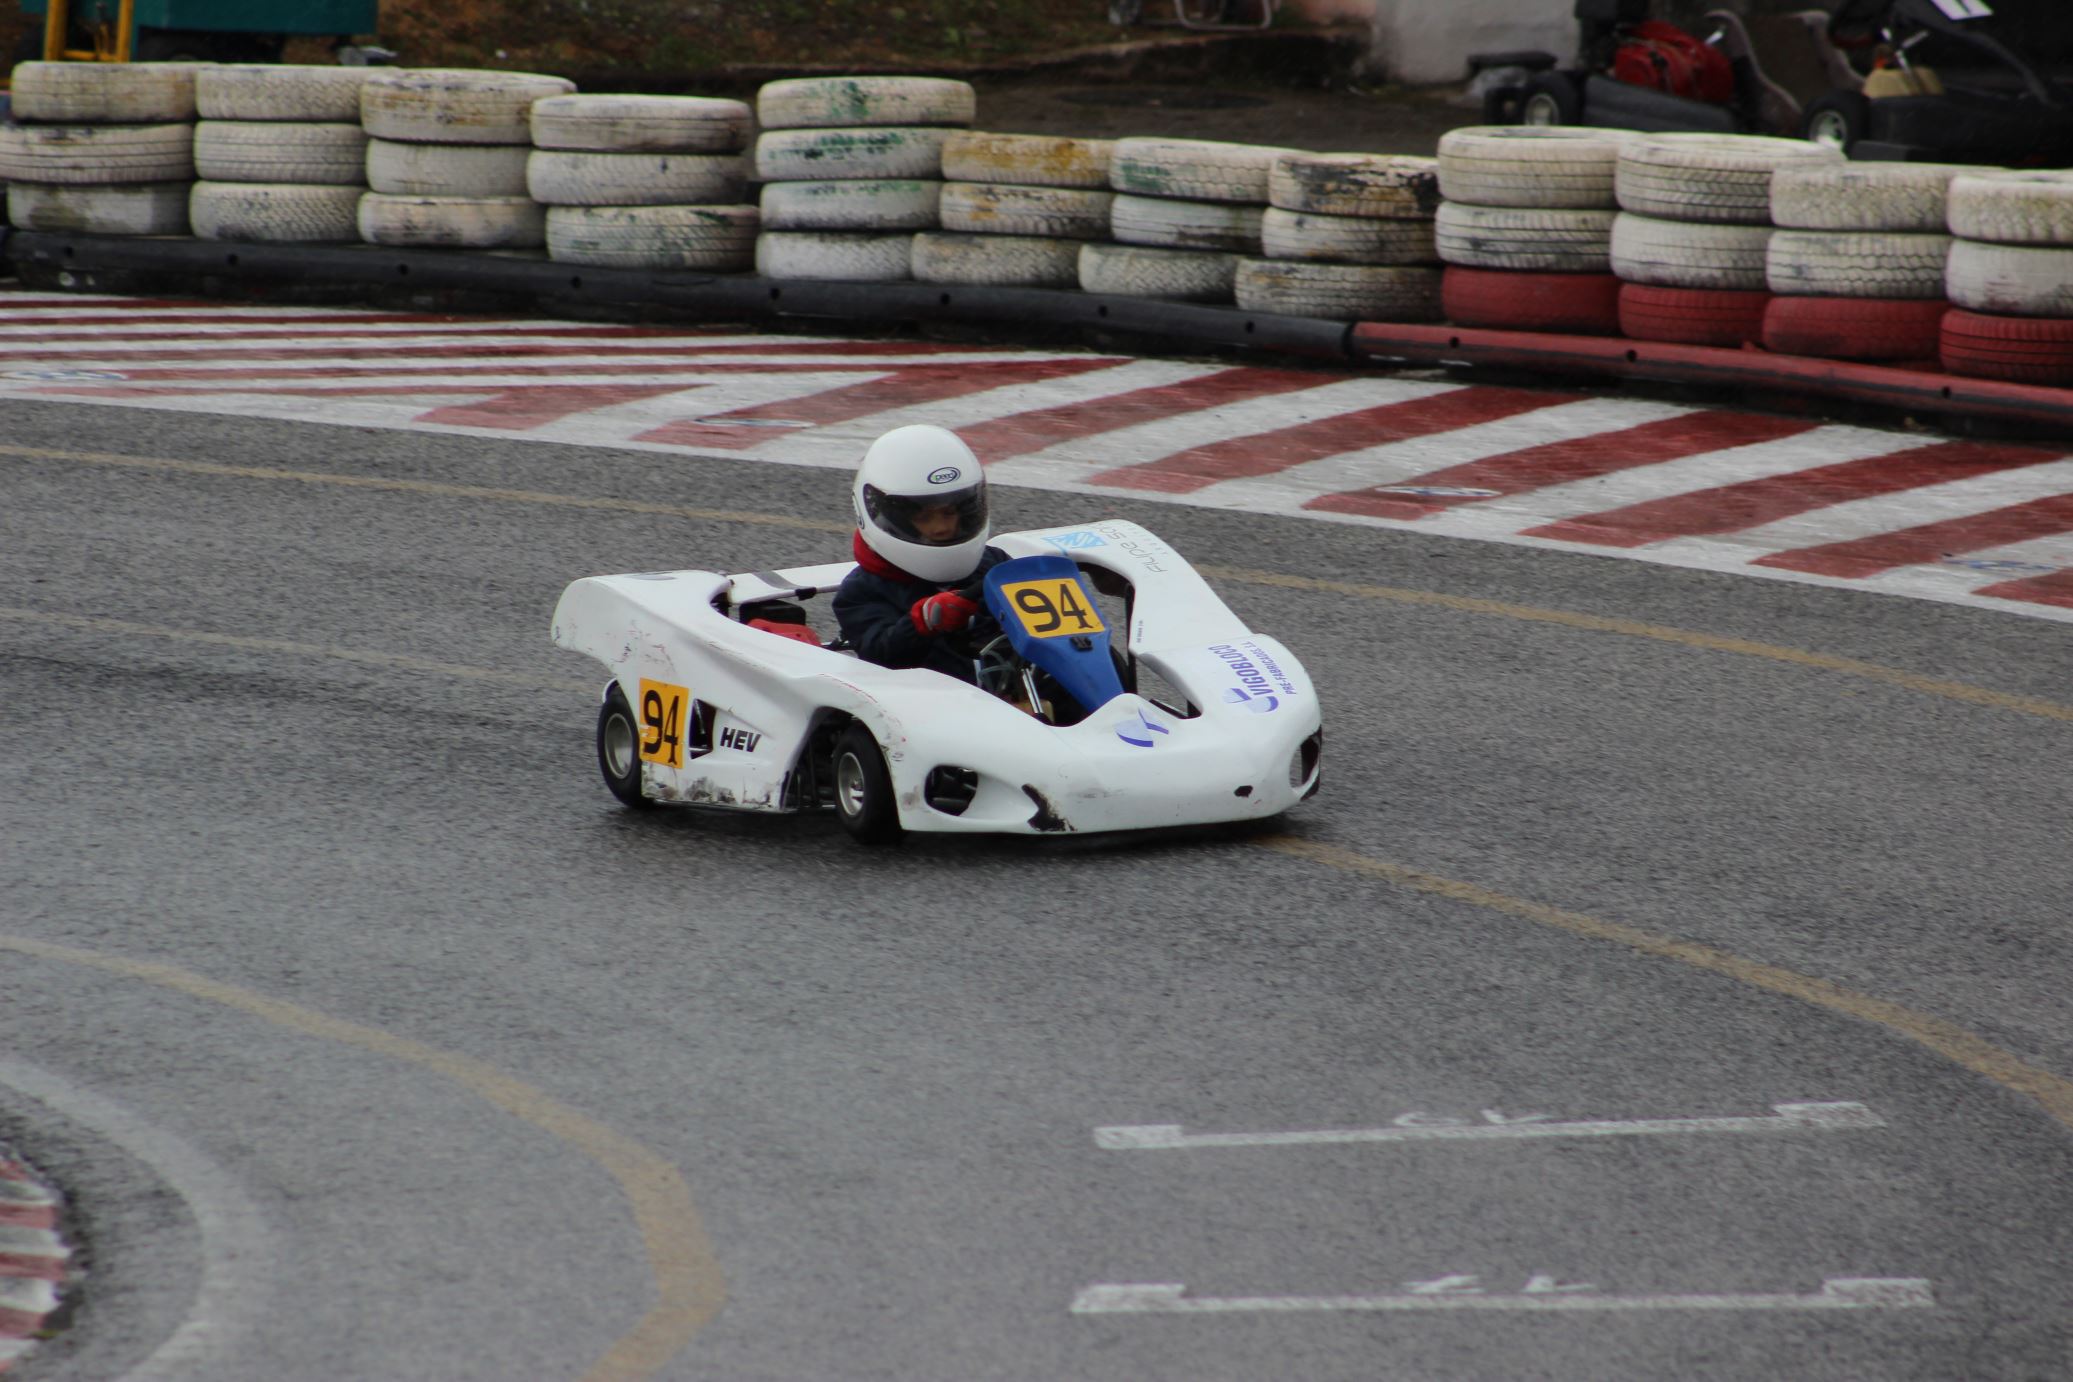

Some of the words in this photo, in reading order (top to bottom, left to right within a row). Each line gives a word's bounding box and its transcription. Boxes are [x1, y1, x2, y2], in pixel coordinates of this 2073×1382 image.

[1015, 583, 1095, 633] 94
[1208, 644, 1275, 696] VIGOBLOCO
[643, 689, 680, 765] 94
[719, 726, 762, 753] HEV
